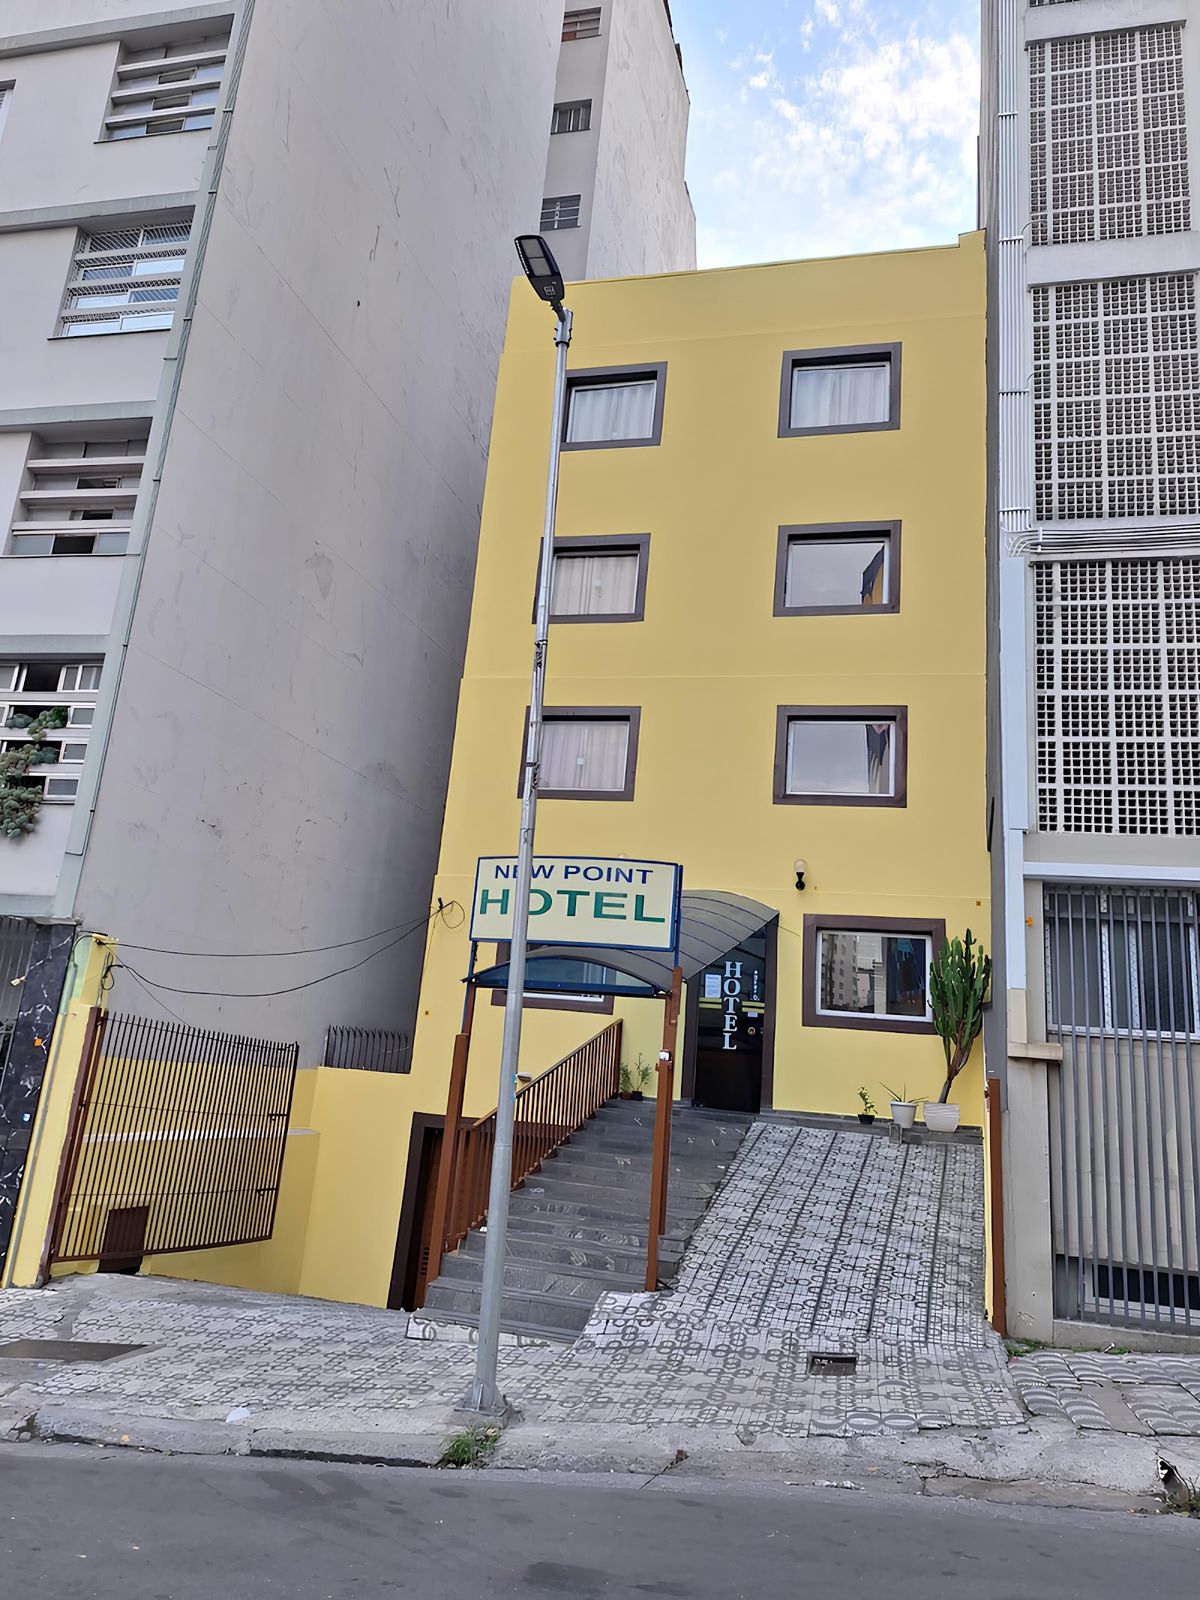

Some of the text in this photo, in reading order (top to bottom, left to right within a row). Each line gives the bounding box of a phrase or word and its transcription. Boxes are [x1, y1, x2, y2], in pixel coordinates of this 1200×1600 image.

[564, 865, 653, 884] POINT
[480, 888, 665, 923] HOTEL
[722, 961, 743, 1050] HOTEL
